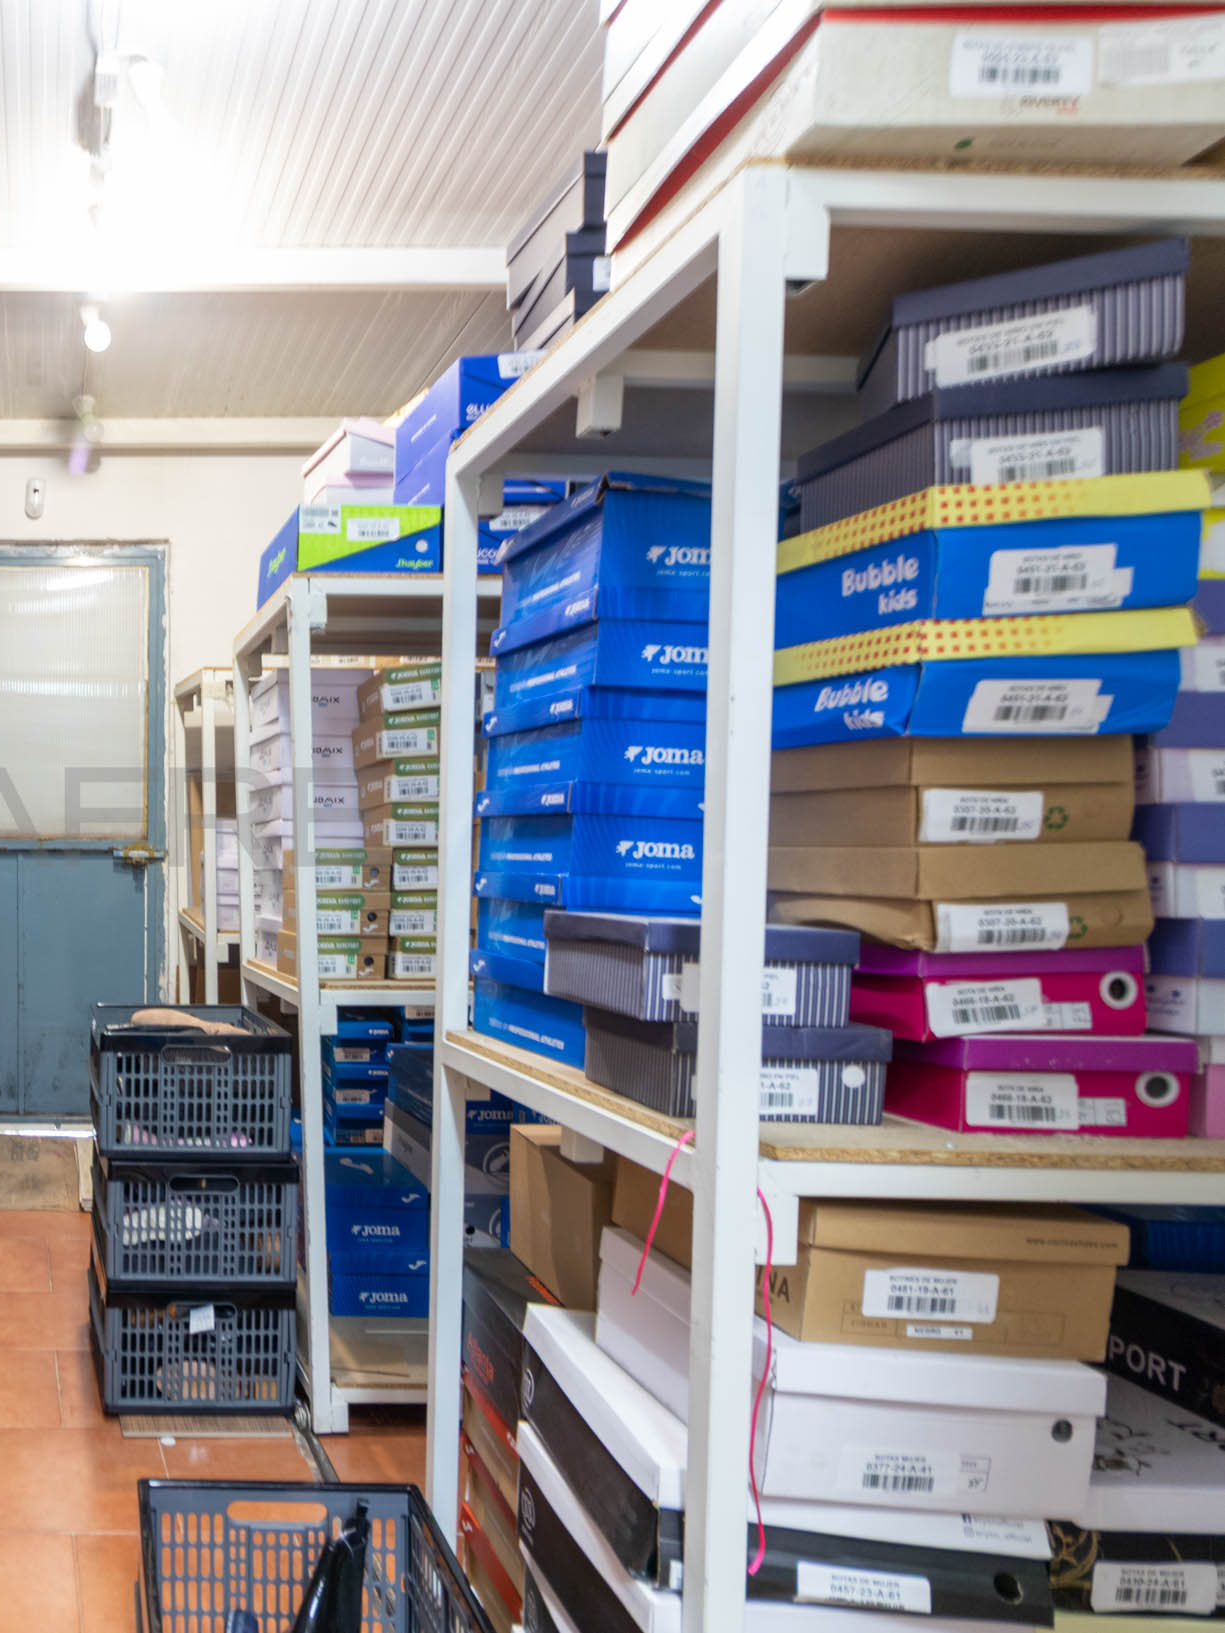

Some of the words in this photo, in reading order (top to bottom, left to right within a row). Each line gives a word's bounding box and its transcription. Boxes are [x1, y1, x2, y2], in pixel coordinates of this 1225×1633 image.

[664, 546, 711, 567] Jom
[841, 553, 919, 597] Bubble
[878, 588, 918, 615] kids
[659, 644, 708, 665] Jom
[814, 677, 888, 712] Bubble
[843, 708, 886, 730] kids
[1109, 1335, 1187, 1391] PORT
